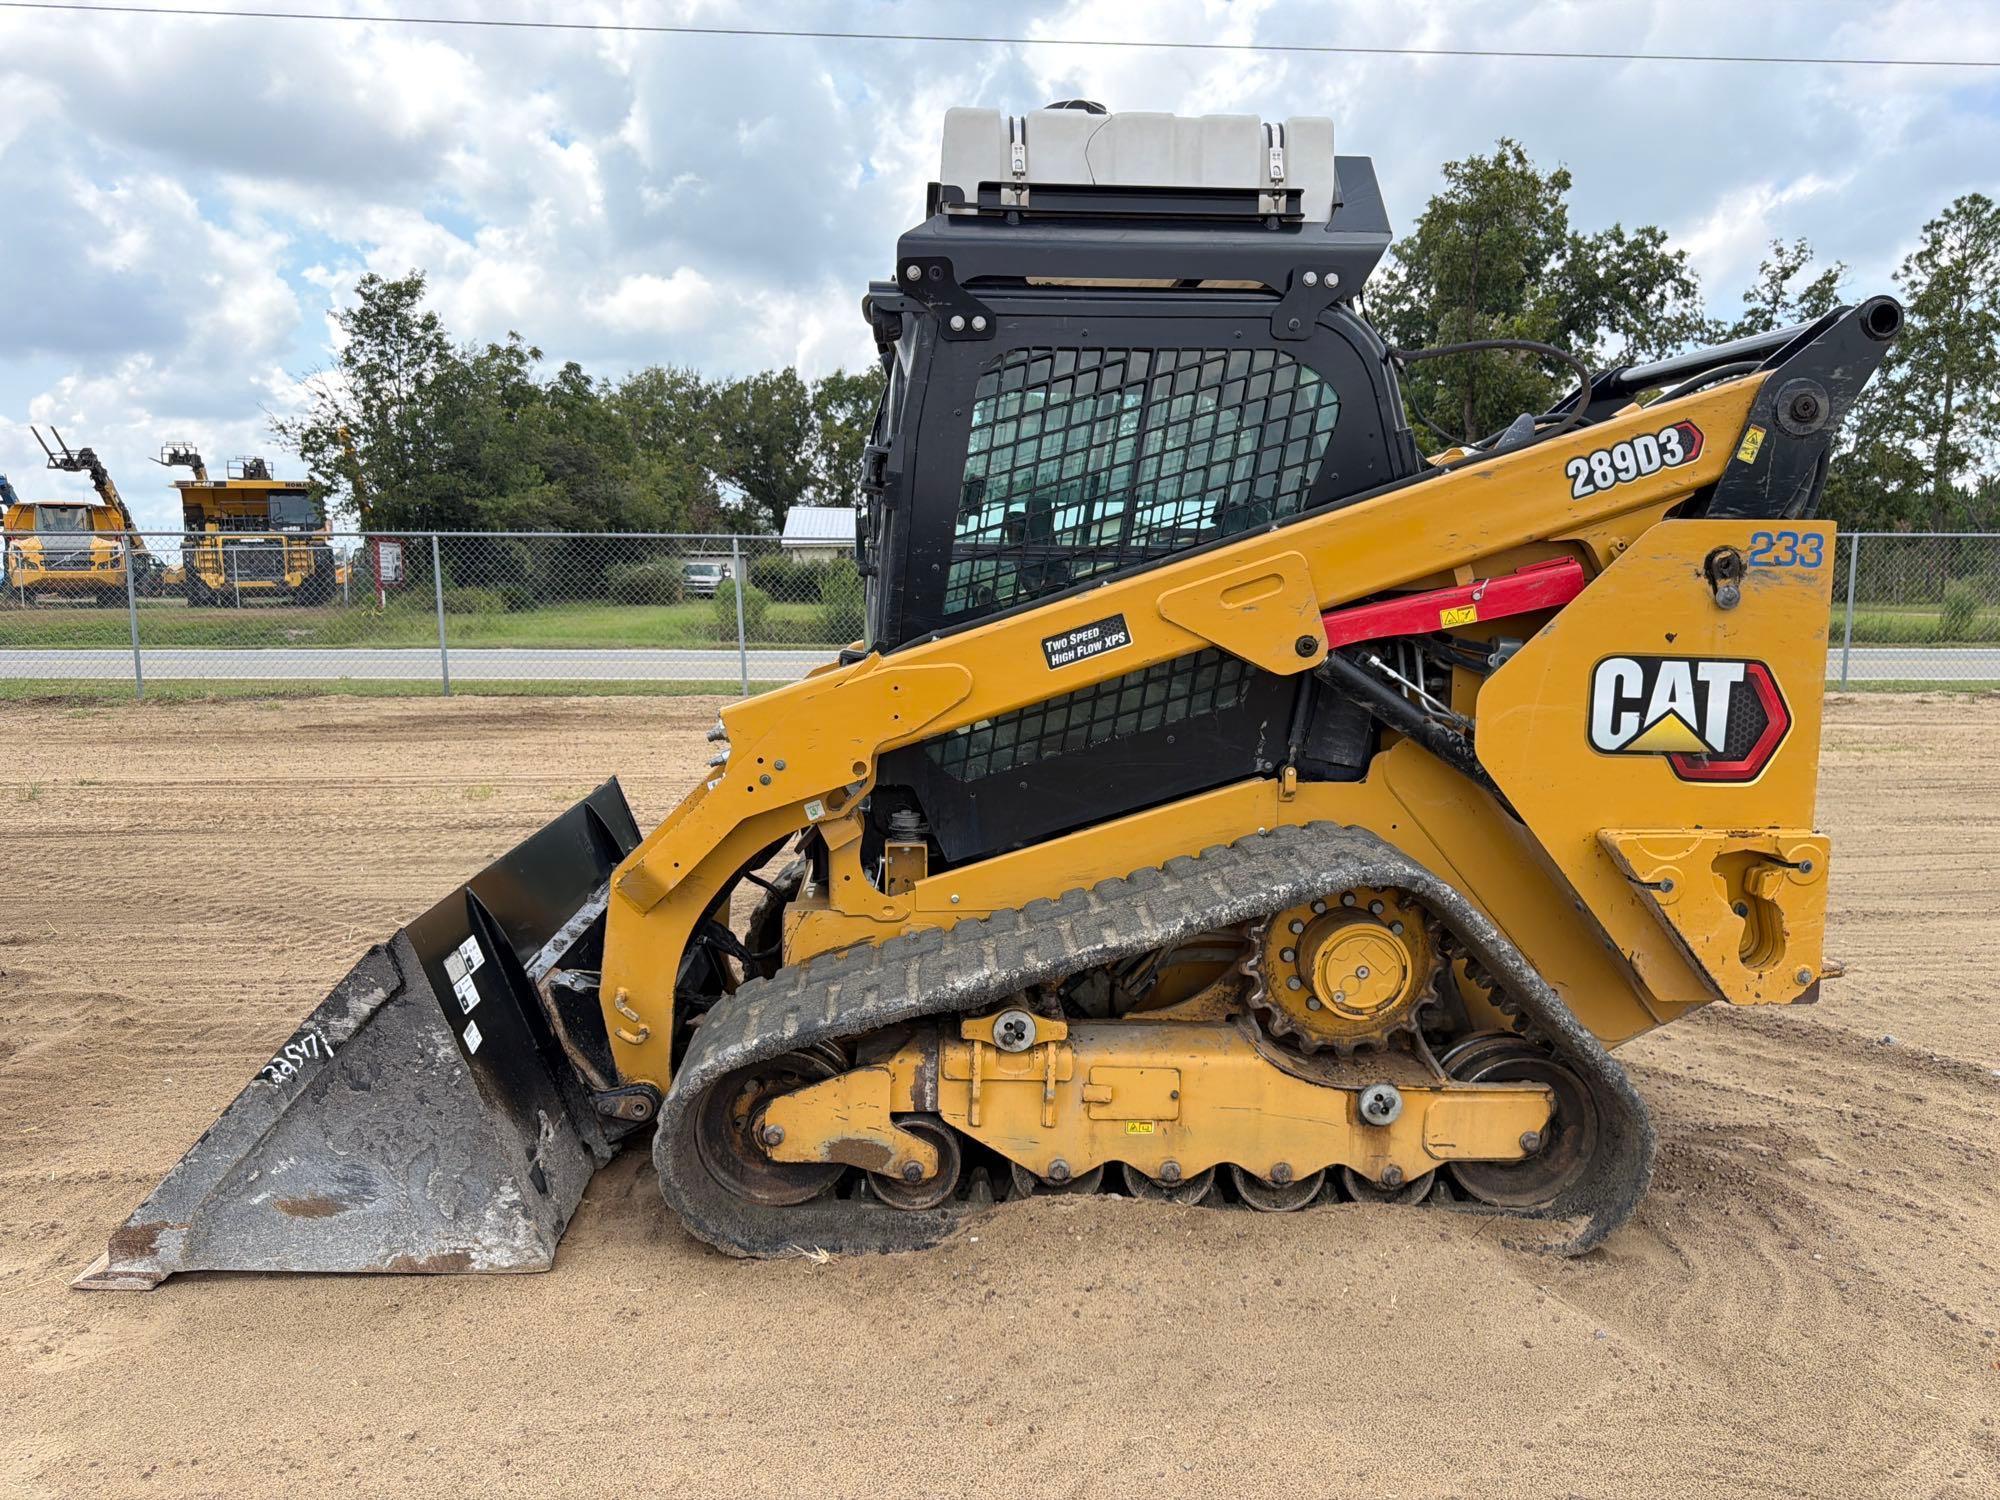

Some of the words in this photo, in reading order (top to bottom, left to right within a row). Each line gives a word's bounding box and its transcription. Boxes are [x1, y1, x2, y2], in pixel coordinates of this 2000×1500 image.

[1567, 427, 1685, 498] 289D3
[1748, 532, 1825, 568] 233
[1046, 638, 1068, 653] TWO
[1070, 627, 1100, 645] SPEED
[1051, 650, 1075, 666] HIGH
[1077, 640, 1102, 657] FLOW
[1105, 631, 1126, 648] XPS
[1592, 658, 1745, 753] CAT
